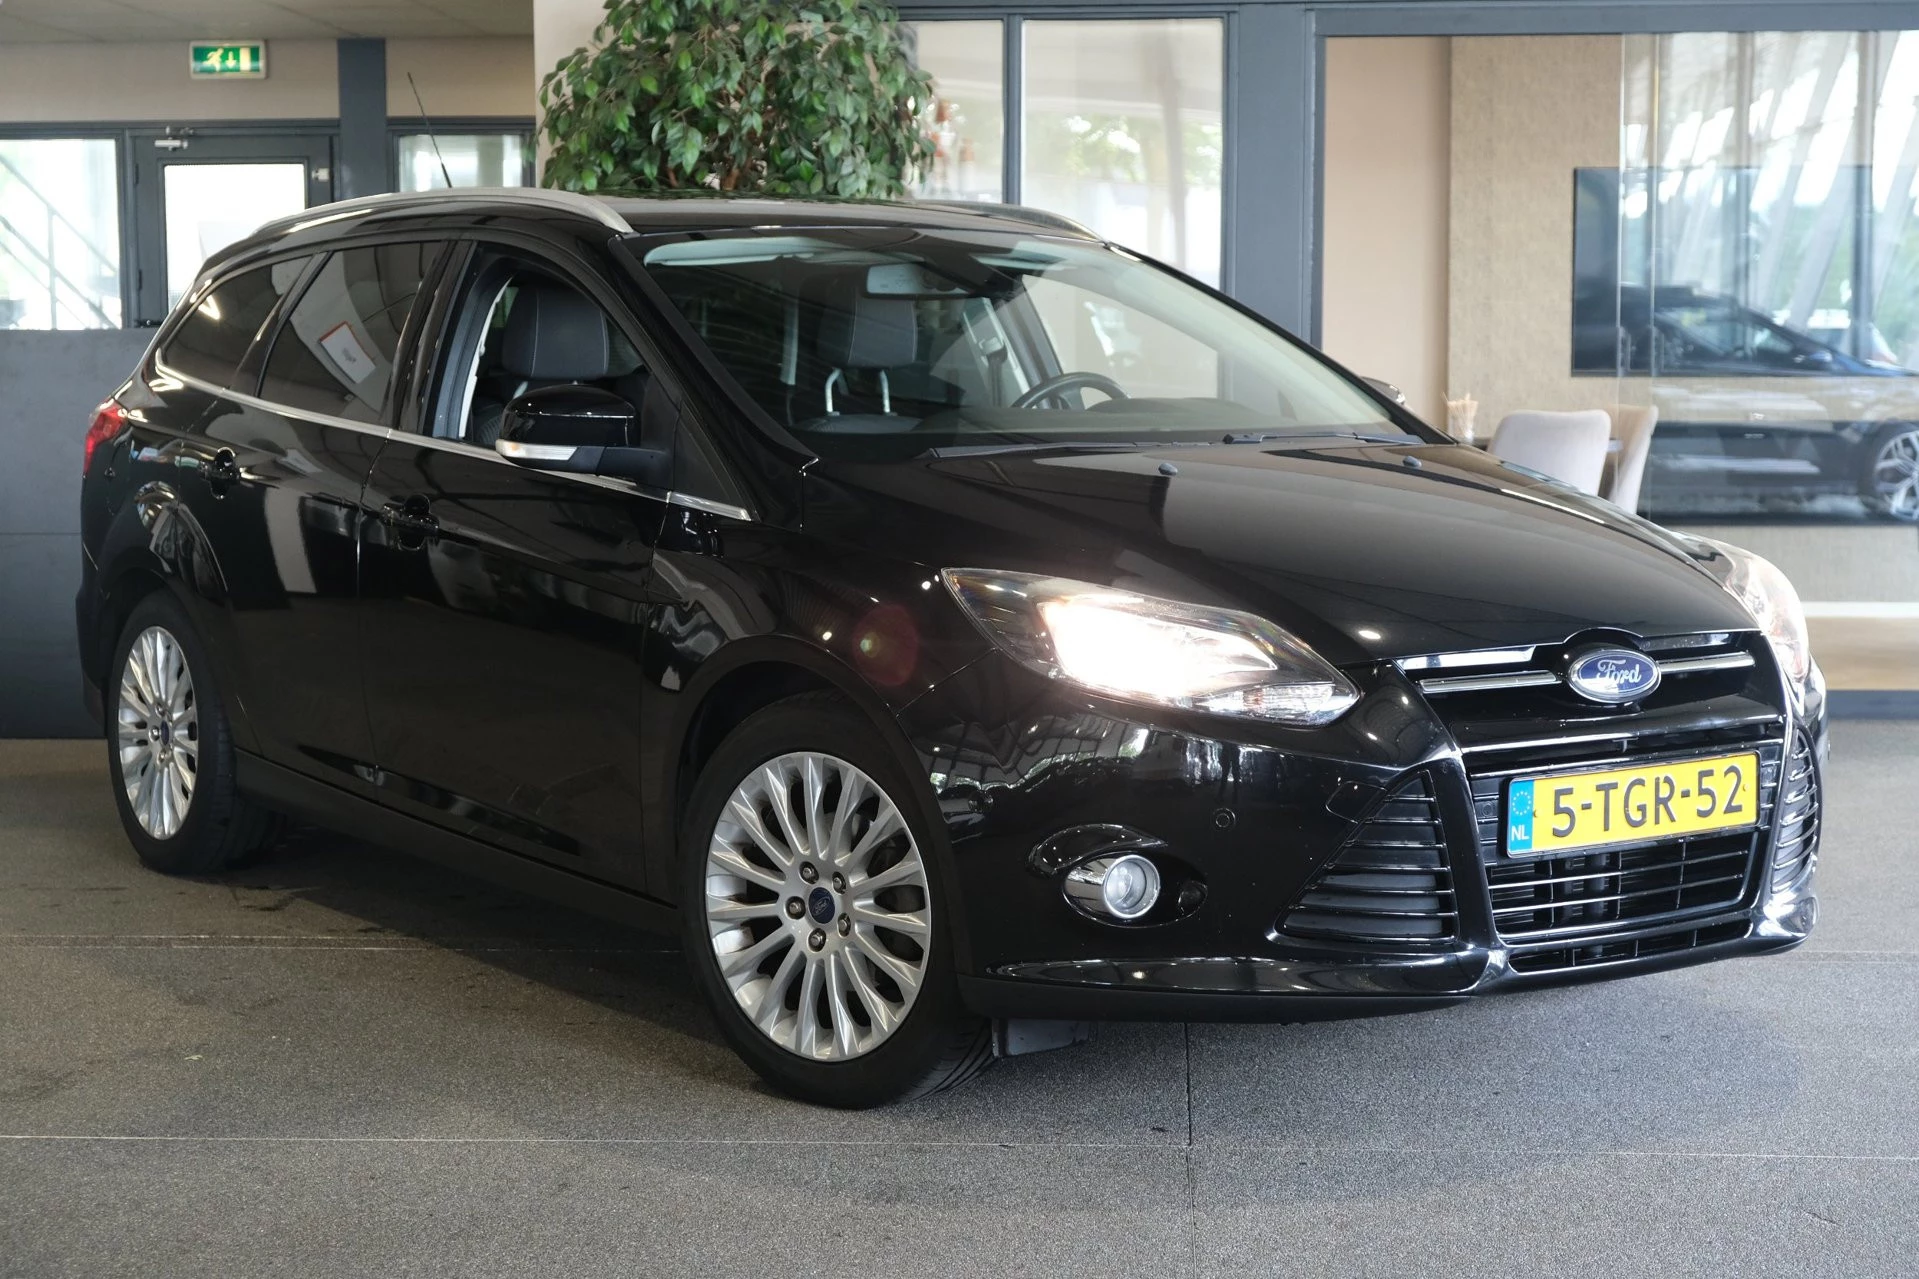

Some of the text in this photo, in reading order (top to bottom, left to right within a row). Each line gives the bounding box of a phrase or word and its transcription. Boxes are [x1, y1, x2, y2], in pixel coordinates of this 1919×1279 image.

[1596, 659, 1641, 684] Ford
[1552, 765, 1743, 838] 5-TGR-52
[1511, 825, 1529, 841] NL
